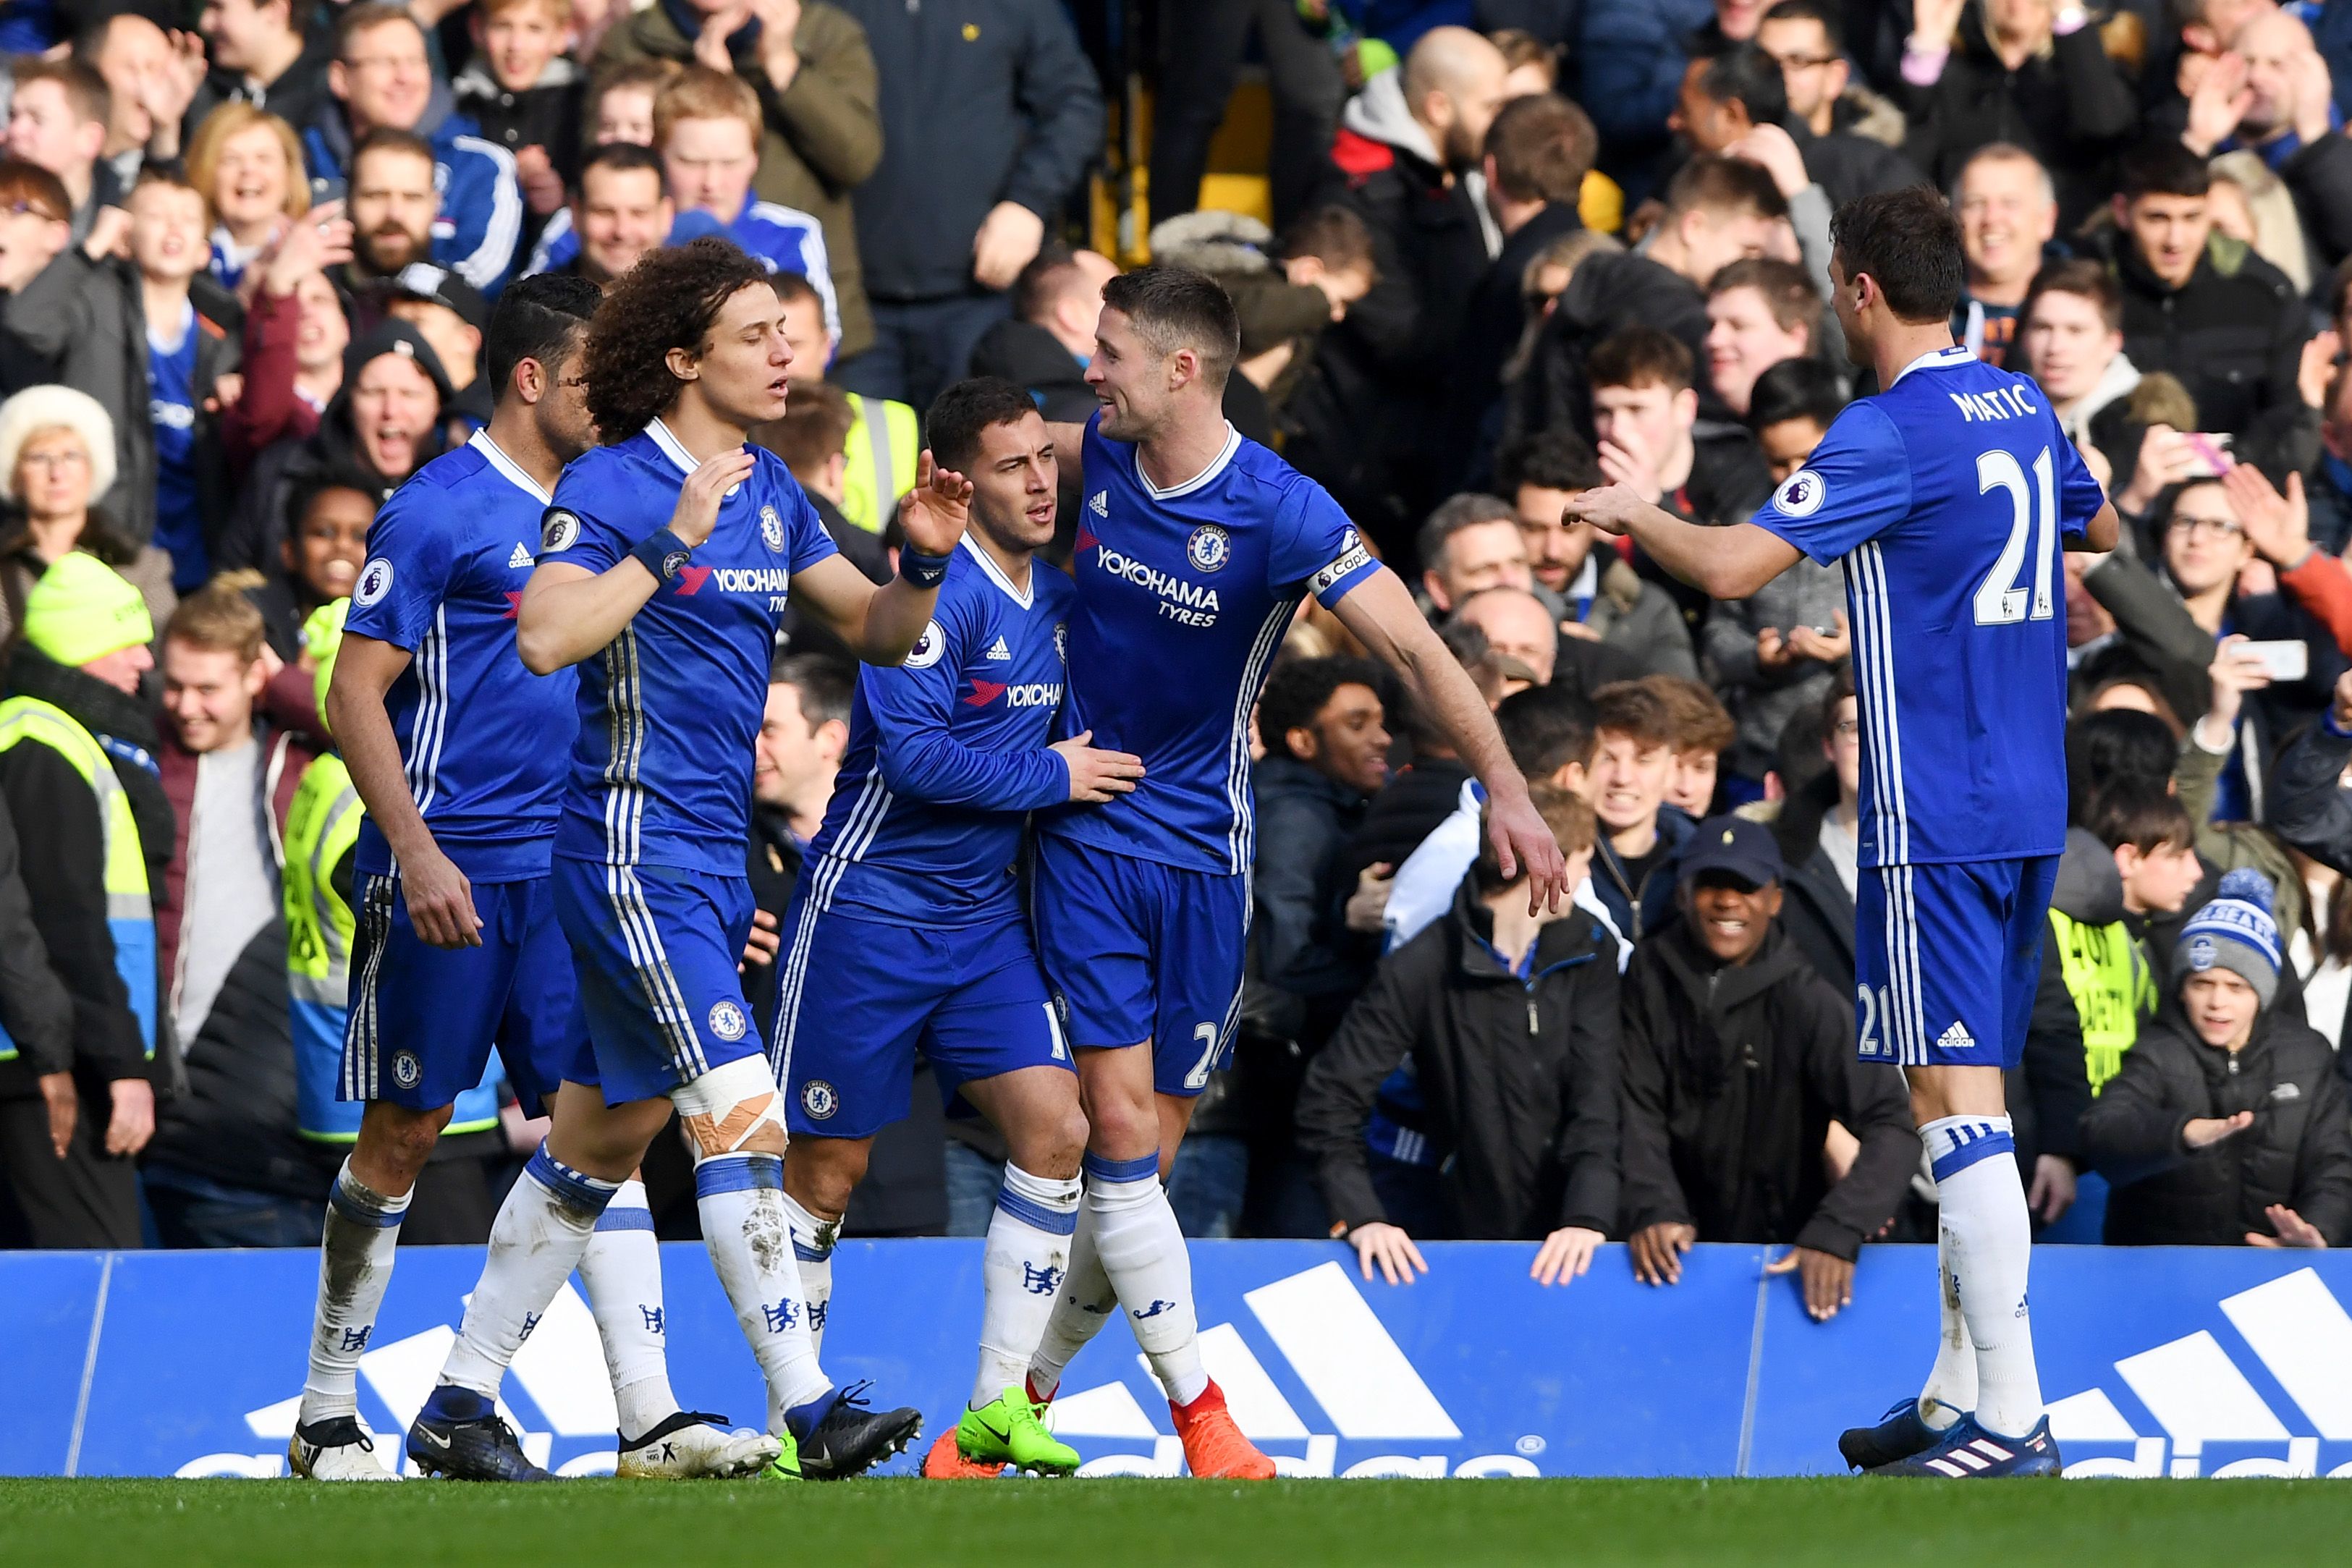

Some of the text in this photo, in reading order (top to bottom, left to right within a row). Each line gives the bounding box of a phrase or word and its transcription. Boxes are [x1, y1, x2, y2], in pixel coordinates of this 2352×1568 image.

[1949, 384, 2036, 422] MATIC
[1088, 499, 1109, 518] adidas
[1201, 527, 1227, 541] CHELSEA
[1973, 444, 2056, 625] 21
[713, 568, 789, 592] YOKOHAM
[1097, 544, 1219, 611] YOKOHAMA
[1159, 601, 1217, 627] TYRES
[986, 650, 1011, 660] adidas
[1007, 683, 1065, 708] YOKOHA
[1858, 983, 1892, 1056] 21
[1937, 1038, 1975, 1048] adidas
